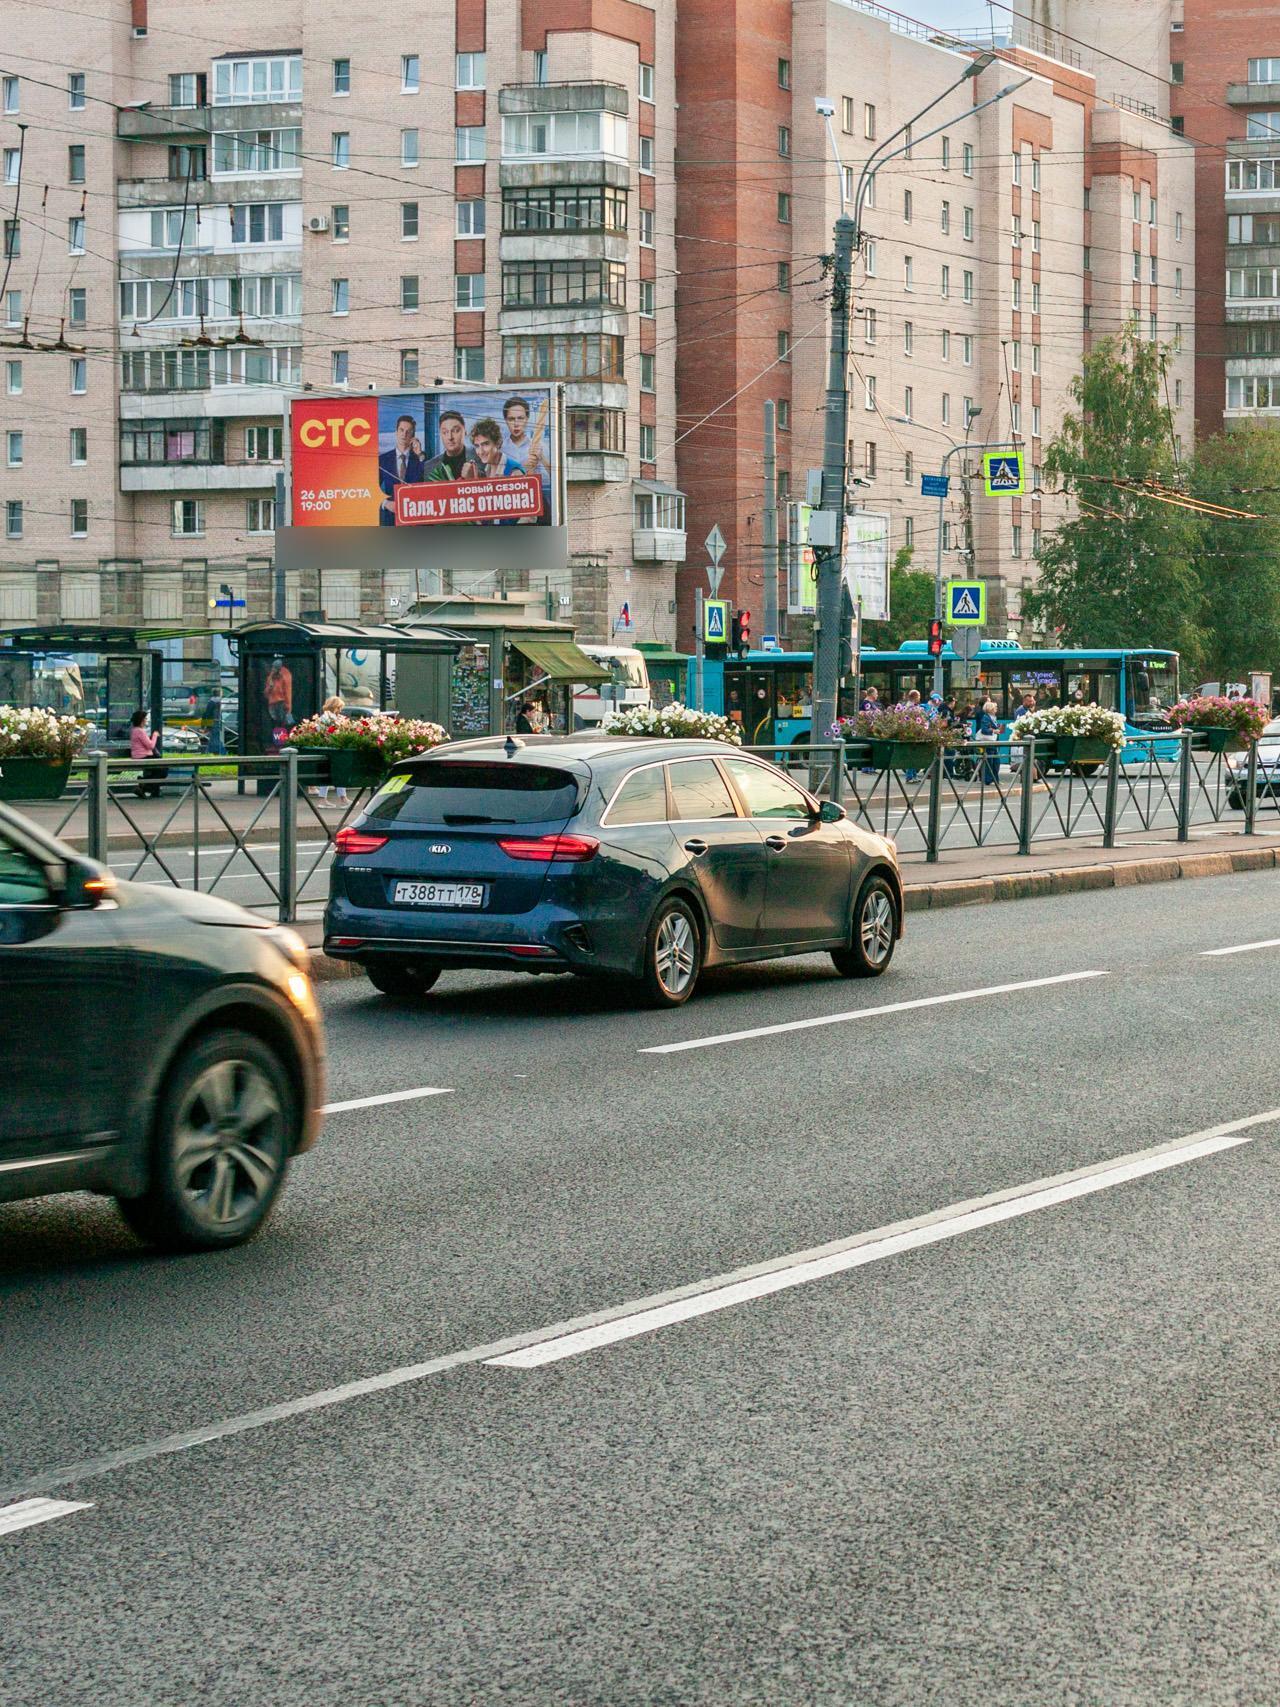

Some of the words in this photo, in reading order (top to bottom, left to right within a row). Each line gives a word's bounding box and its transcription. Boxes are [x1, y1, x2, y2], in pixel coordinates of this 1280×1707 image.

[300, 417, 371, 448] СТС
[300, 489, 316, 500] 26
[318, 488, 372, 499] АВГУСТА
[457, 484, 493, 495] НОВЫЙ
[495, 482, 529, 492] СЕЗОН
[300, 501, 331, 511] 19:00
[402, 497, 438, 517] Галя,
[438, 498, 447, 516] у
[449, 496, 475, 514] нас
[477, 488, 535, 512] отмена!
[431, 845, 447, 853] KIA
[400, 884, 455, 901] Т388ТТ
[457, 886, 480, 898] 178
